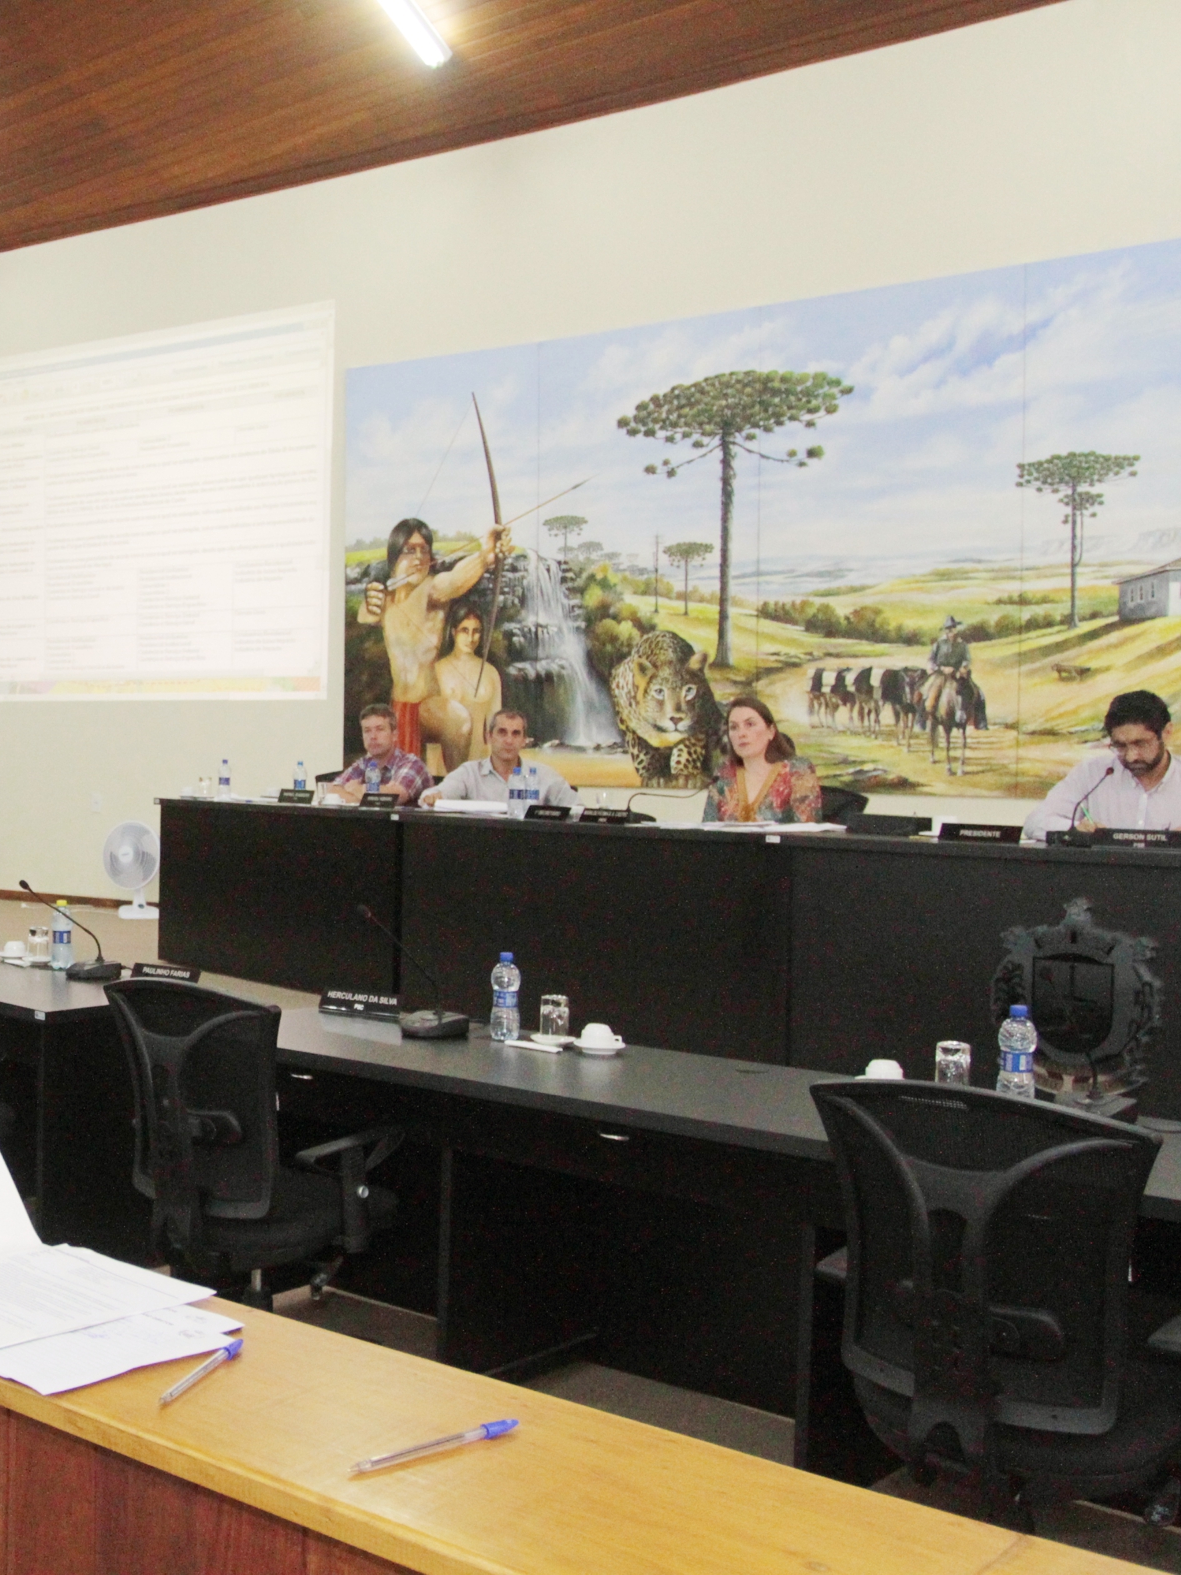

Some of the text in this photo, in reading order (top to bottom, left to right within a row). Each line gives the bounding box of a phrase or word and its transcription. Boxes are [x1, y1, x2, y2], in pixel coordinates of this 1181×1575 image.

[959, 829, 1001, 838] PRESIDENTE
[1112, 832, 1168, 842] GERSON SUTIL
[142, 966, 190, 978] PAULINHO FARIAS
[327, 990, 398, 1005] HERCULANO DA SILVA
